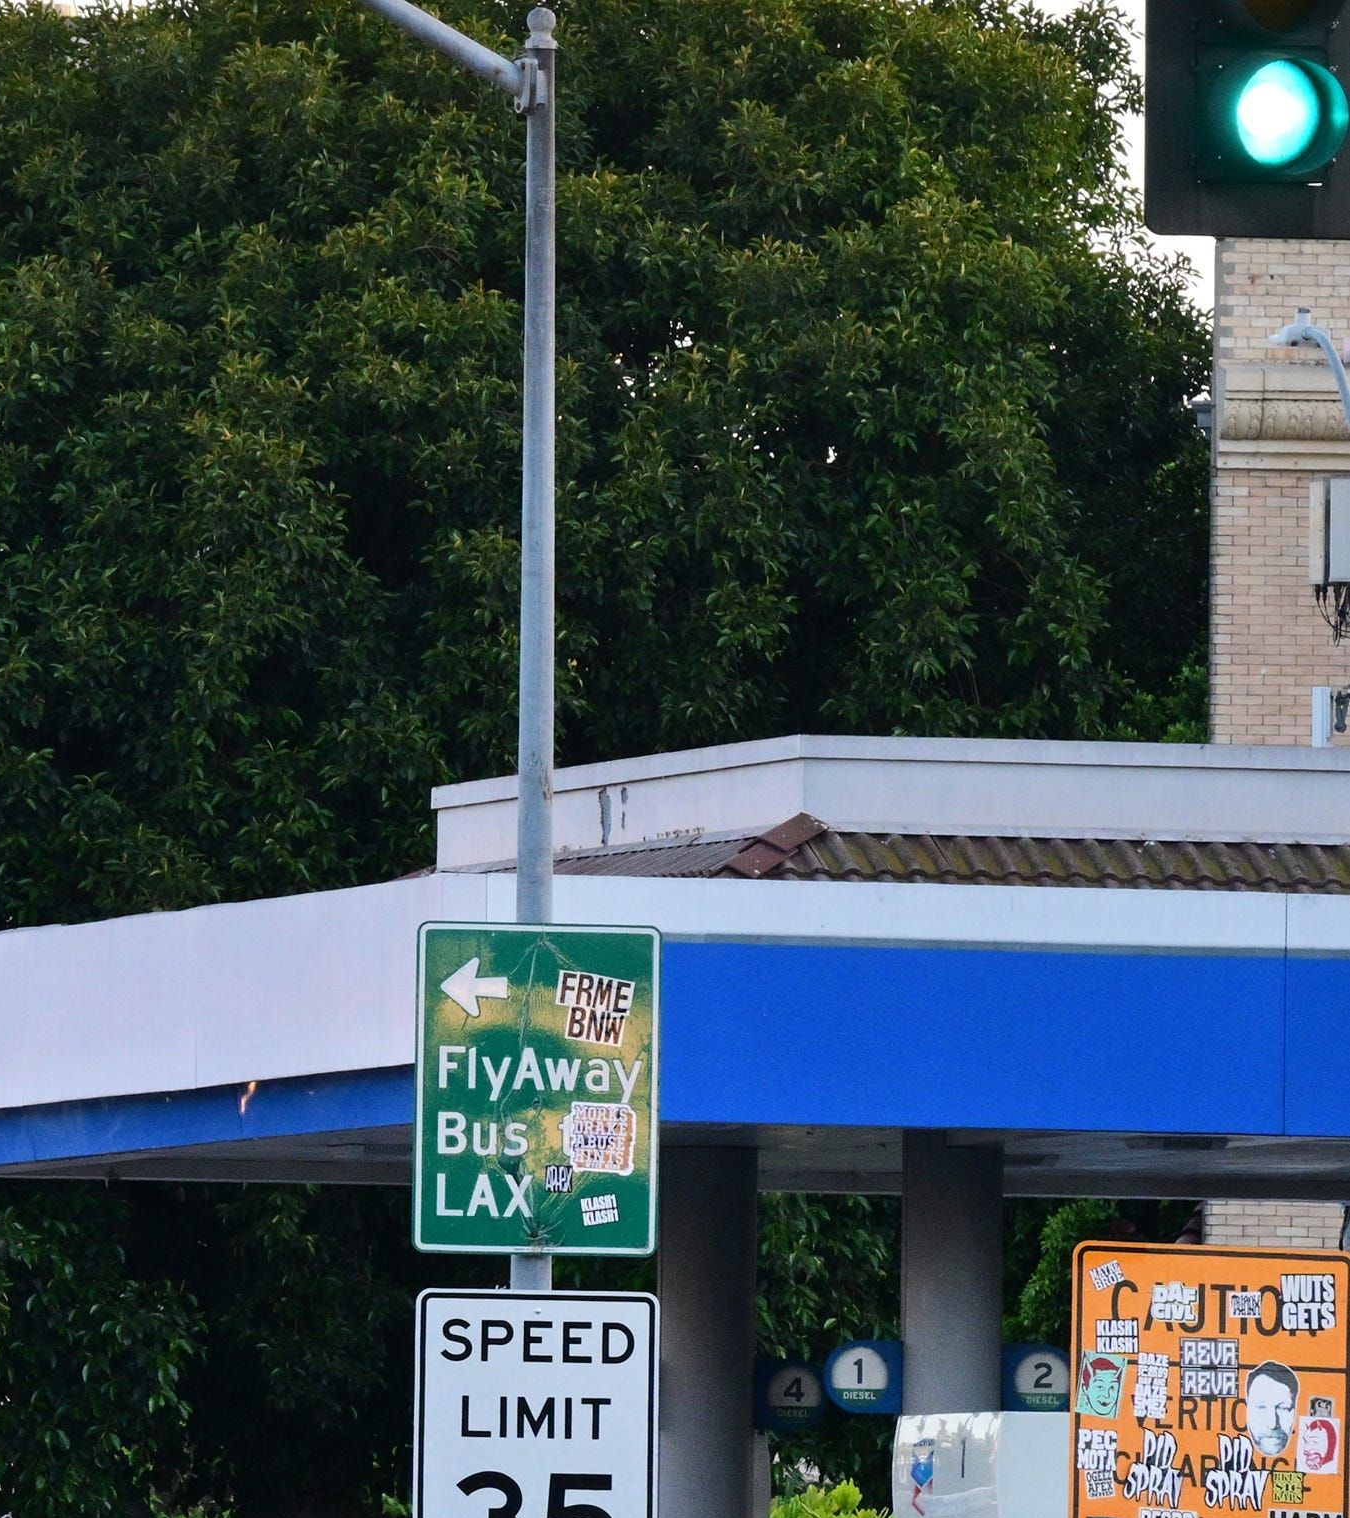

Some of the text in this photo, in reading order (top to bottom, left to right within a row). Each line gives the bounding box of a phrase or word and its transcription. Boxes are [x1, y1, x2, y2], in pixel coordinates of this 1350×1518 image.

[560, 973, 631, 1013] FRME
[568, 1007, 624, 1045] BNW
[438, 1045, 643, 1104] FlyAway
[437, 1111, 529, 1157] Bus
[436, 1173, 533, 1218] LAX
[1153, 1282, 1197, 1304] DAF
[1281, 1275, 1335, 1302] WUTS
[1097, 1320, 1138, 1336] KLASH1
[1282, 1302, 1336, 1330] GETS
[441, 1318, 635, 1364] SPEED
[1097, 1337, 1138, 1353] KLASH1
[853, 1358, 863, 1384] 1
[1034, 1362, 1053, 1389] 2
[783, 1377, 805, 1402] 4
[843, 1391, 876, 1400] DIESEL
[1026, 1396, 1059, 1405] DIESEL
[461, 1395, 611, 1439] LIMIT
[1078, 1429, 1117, 1450] PEC
[1077, 1449, 1116, 1471] MOTA
[1123, 1462, 1183, 1509] SPRAY
[1205, 1469, 1271, 1511] SPRAY
